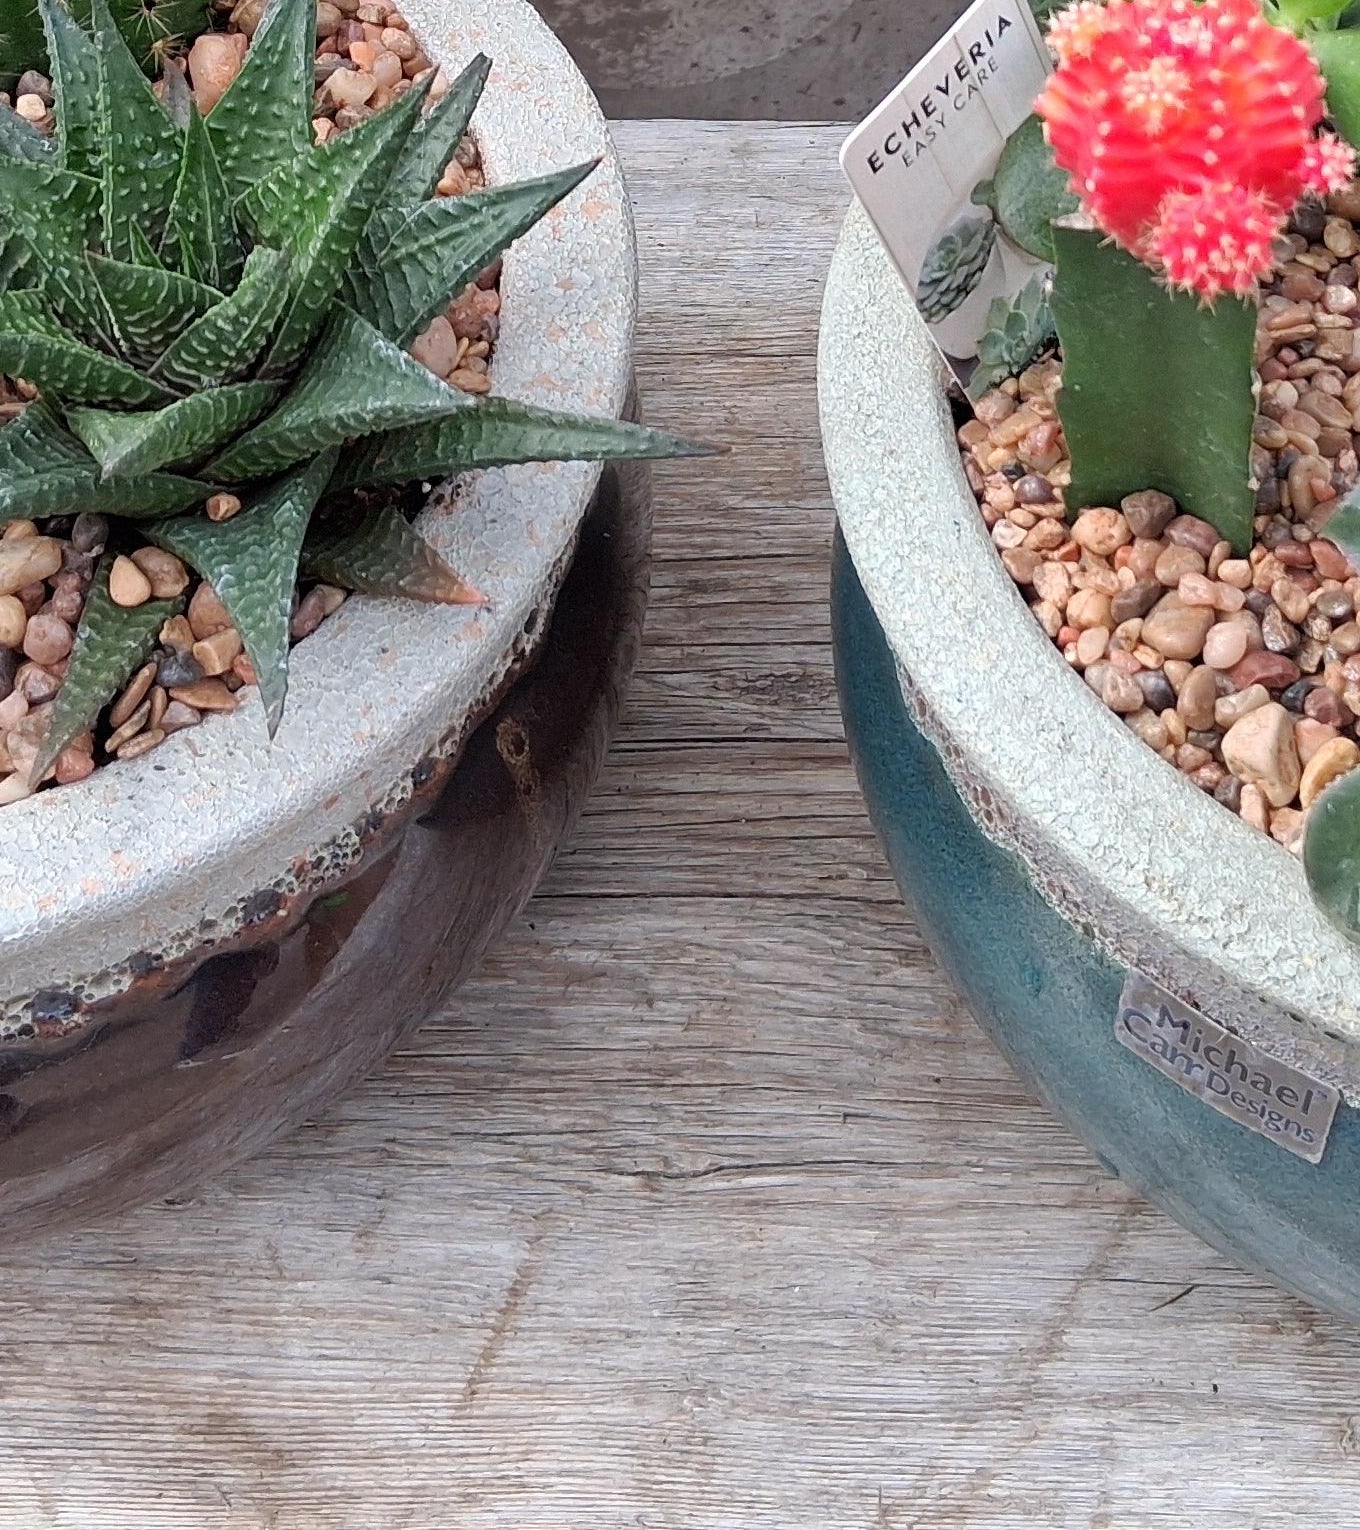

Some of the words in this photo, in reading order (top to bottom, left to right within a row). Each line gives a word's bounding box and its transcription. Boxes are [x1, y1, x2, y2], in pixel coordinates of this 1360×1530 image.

[866, 15, 1013, 174] ECHEVERIA
[901, 112, 947, 167] EASY
[952, 56, 999, 111] CARE
[1122, 1008, 1205, 1076] Carr
[1206, 1070, 1315, 1144] Designs
[1156, 1004, 1314, 1115] Michael
